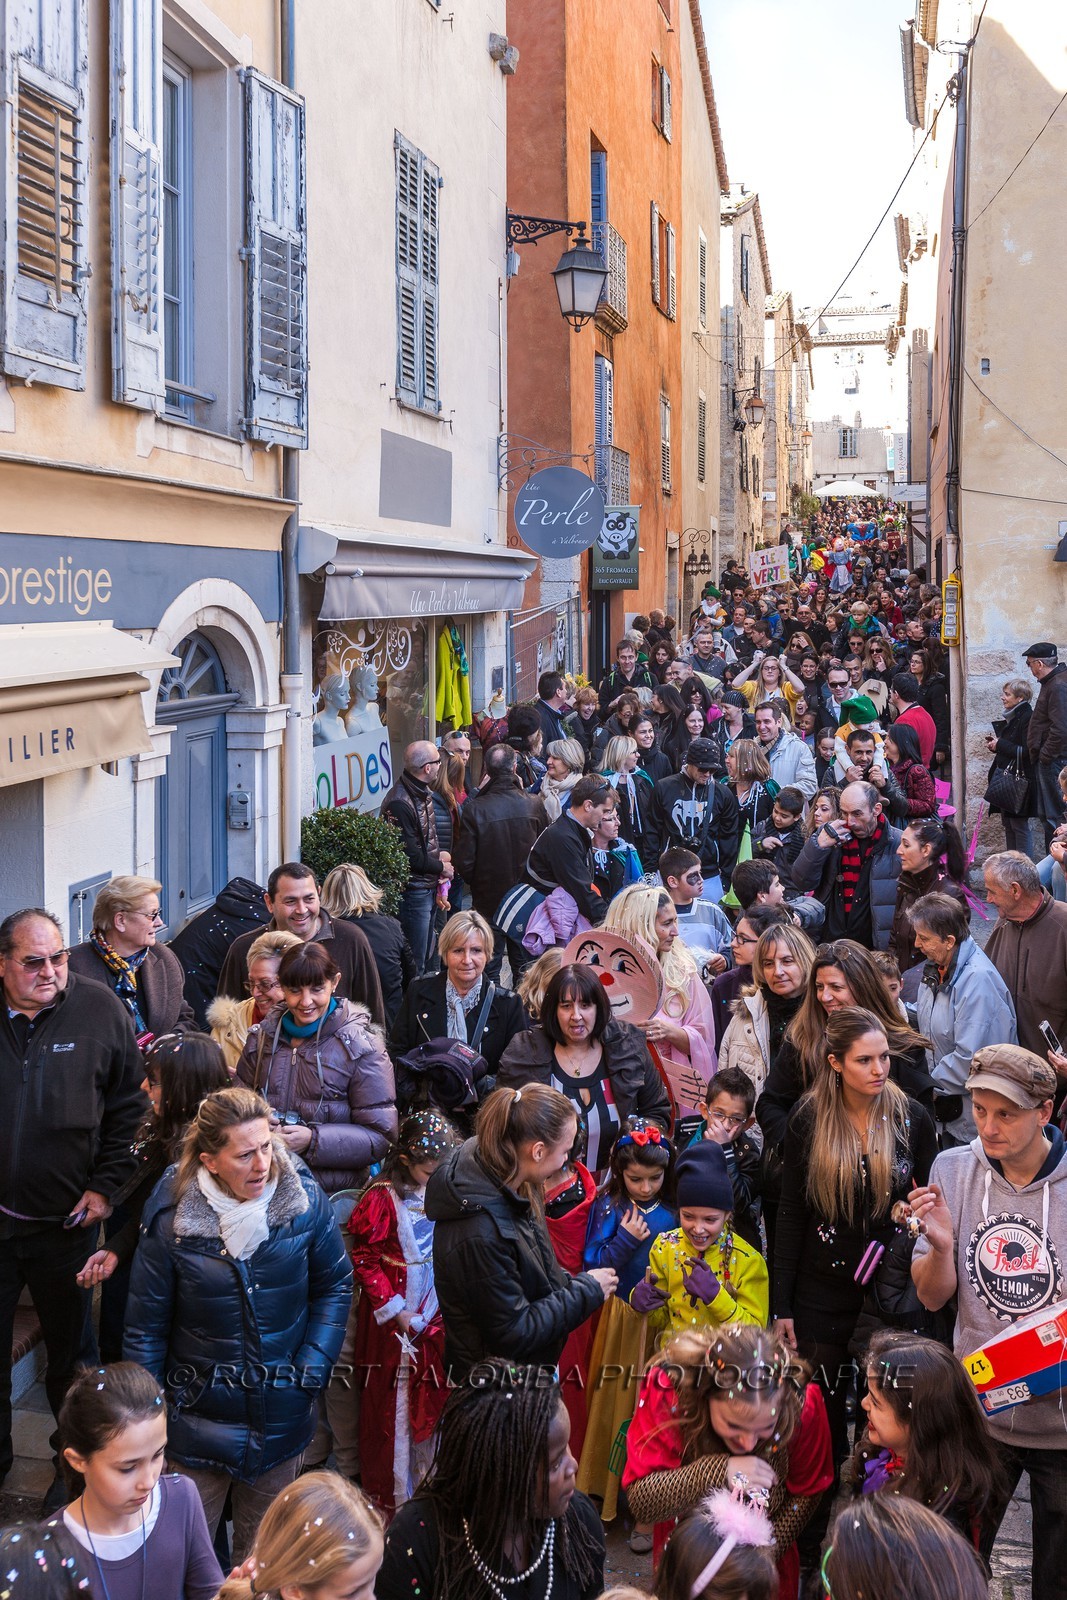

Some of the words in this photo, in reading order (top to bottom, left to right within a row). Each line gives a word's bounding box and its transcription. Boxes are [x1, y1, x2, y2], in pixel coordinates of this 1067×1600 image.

[519, 486, 595, 526] Perle
[760, 552, 776, 566] ILE
[594, 566, 605, 574] 365
[606, 566, 638, 574] FROMAGES
[753, 564, 787, 586] VERTE
[996, 1277, 1030, 1297] LEMON
[991, 1290, 1019, 1308] ARTIFICIAL
[1020, 1292, 1042, 1308] FLAVORS
[971, 1359, 986, 1376] 17
